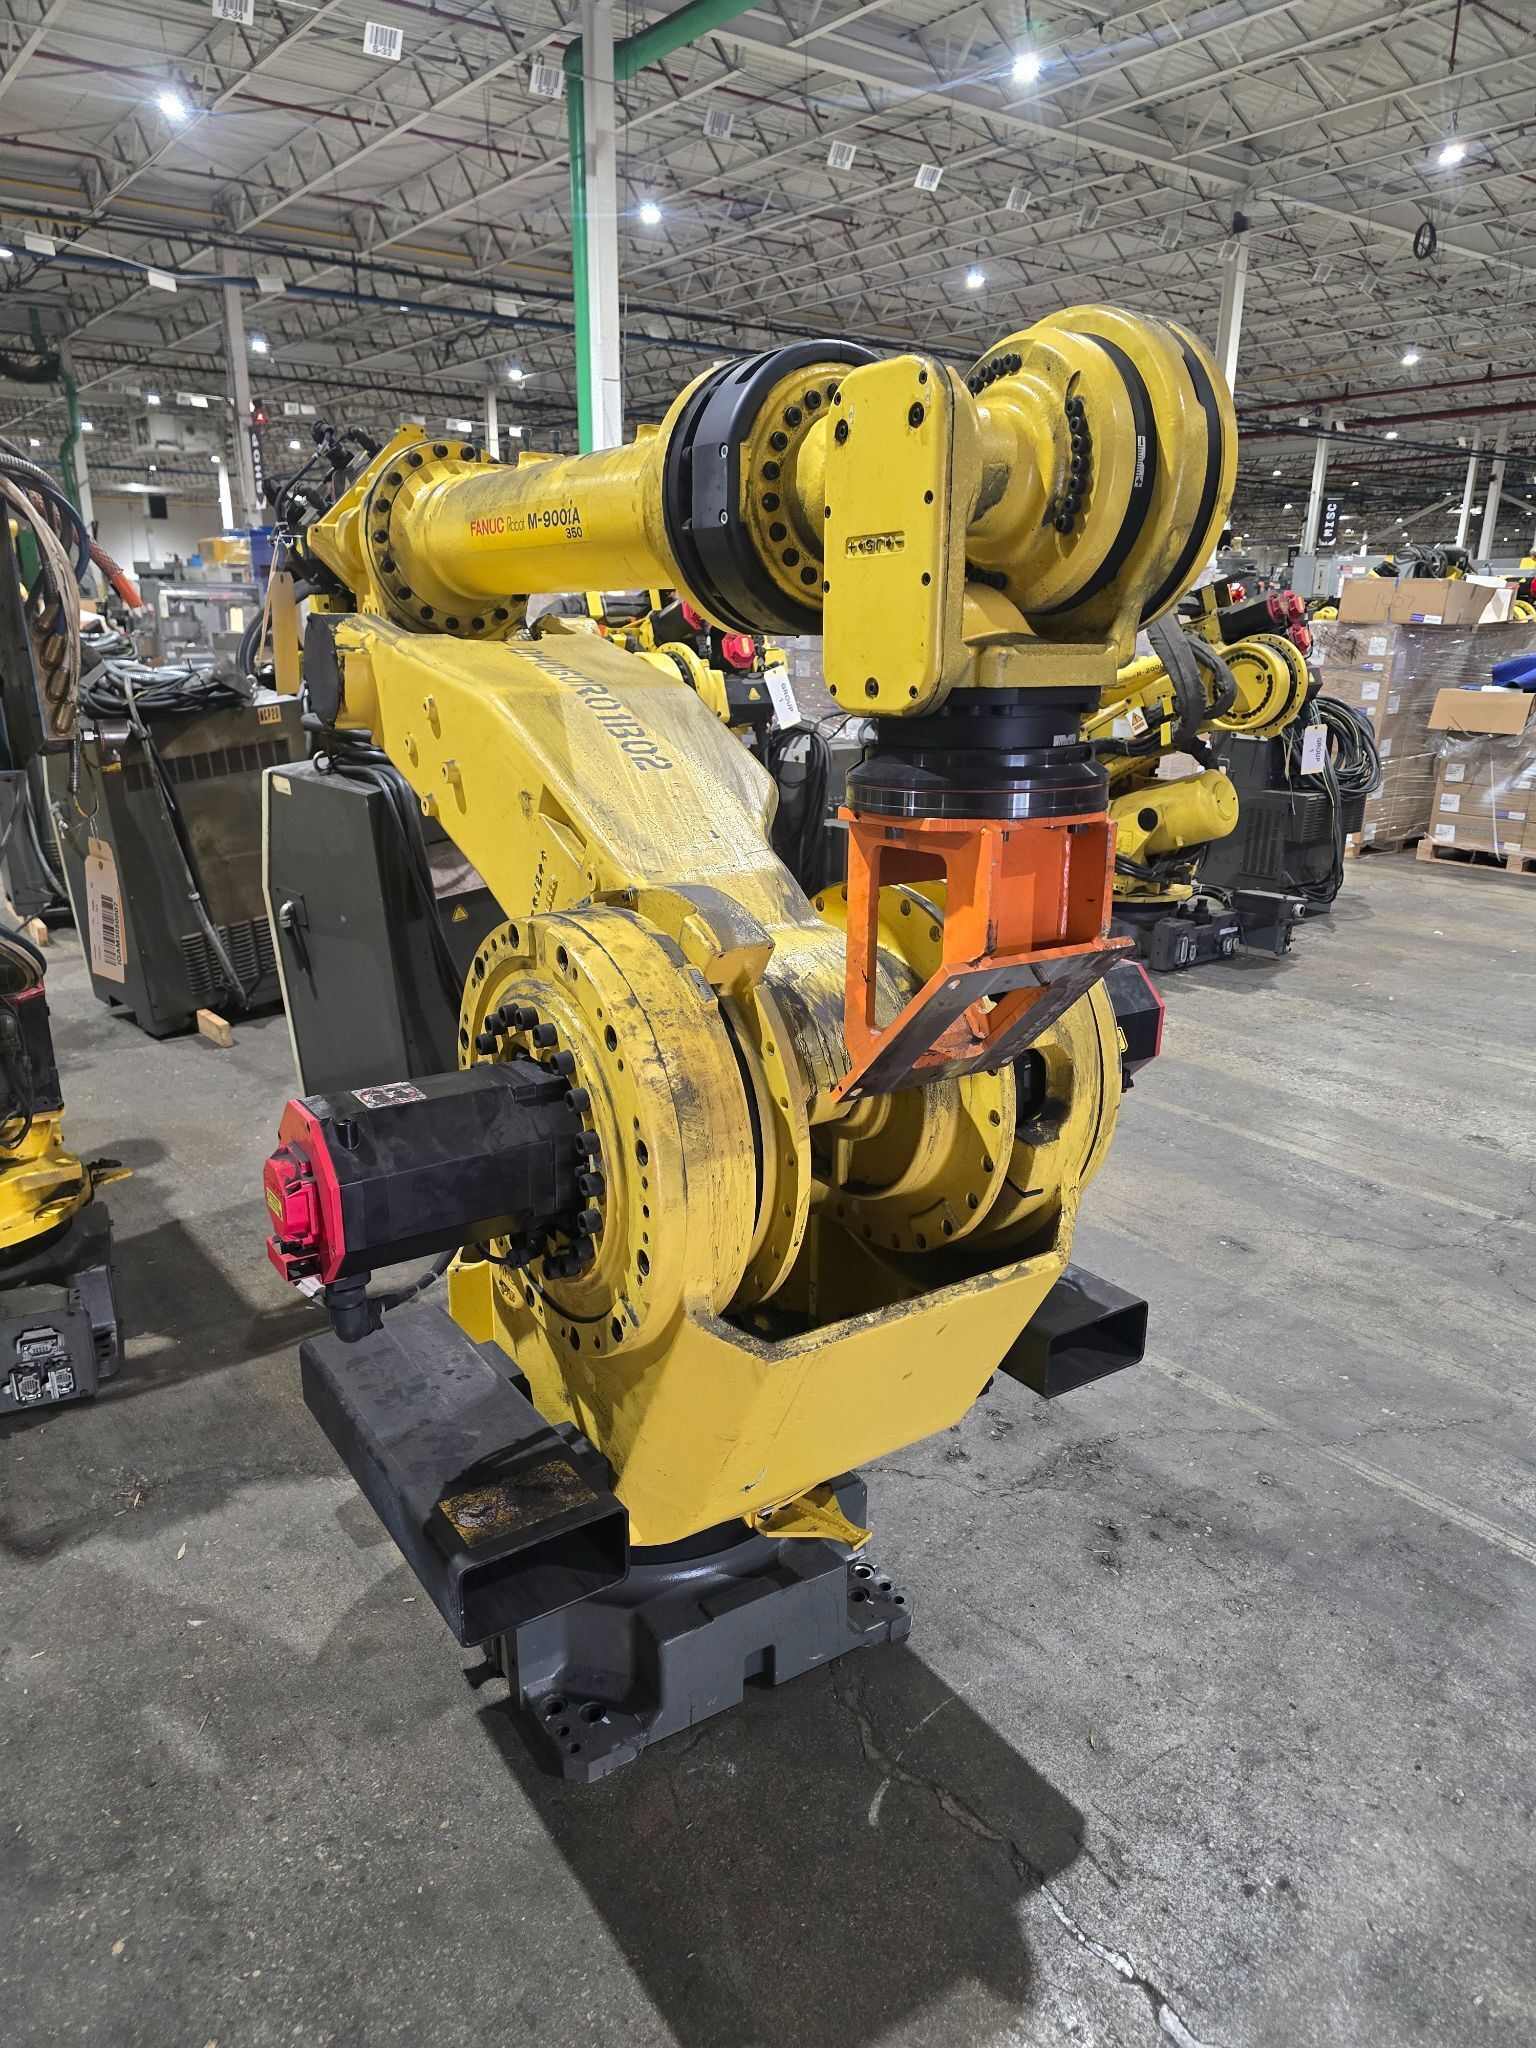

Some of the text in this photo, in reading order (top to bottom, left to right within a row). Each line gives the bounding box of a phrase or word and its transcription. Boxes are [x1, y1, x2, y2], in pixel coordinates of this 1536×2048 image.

[222, 8, 243, 20] S-34
[372, 45, 392, 57] S-33
[470, 516, 505, 536] FANUC
[506, 515, 526, 533] Robot
[1323, 503, 1338, 537] MISC
[565, 526, 583, 539] 350
[780, 682, 794, 712] GROUP
[1314, 737, 1323, 762] GROUP
